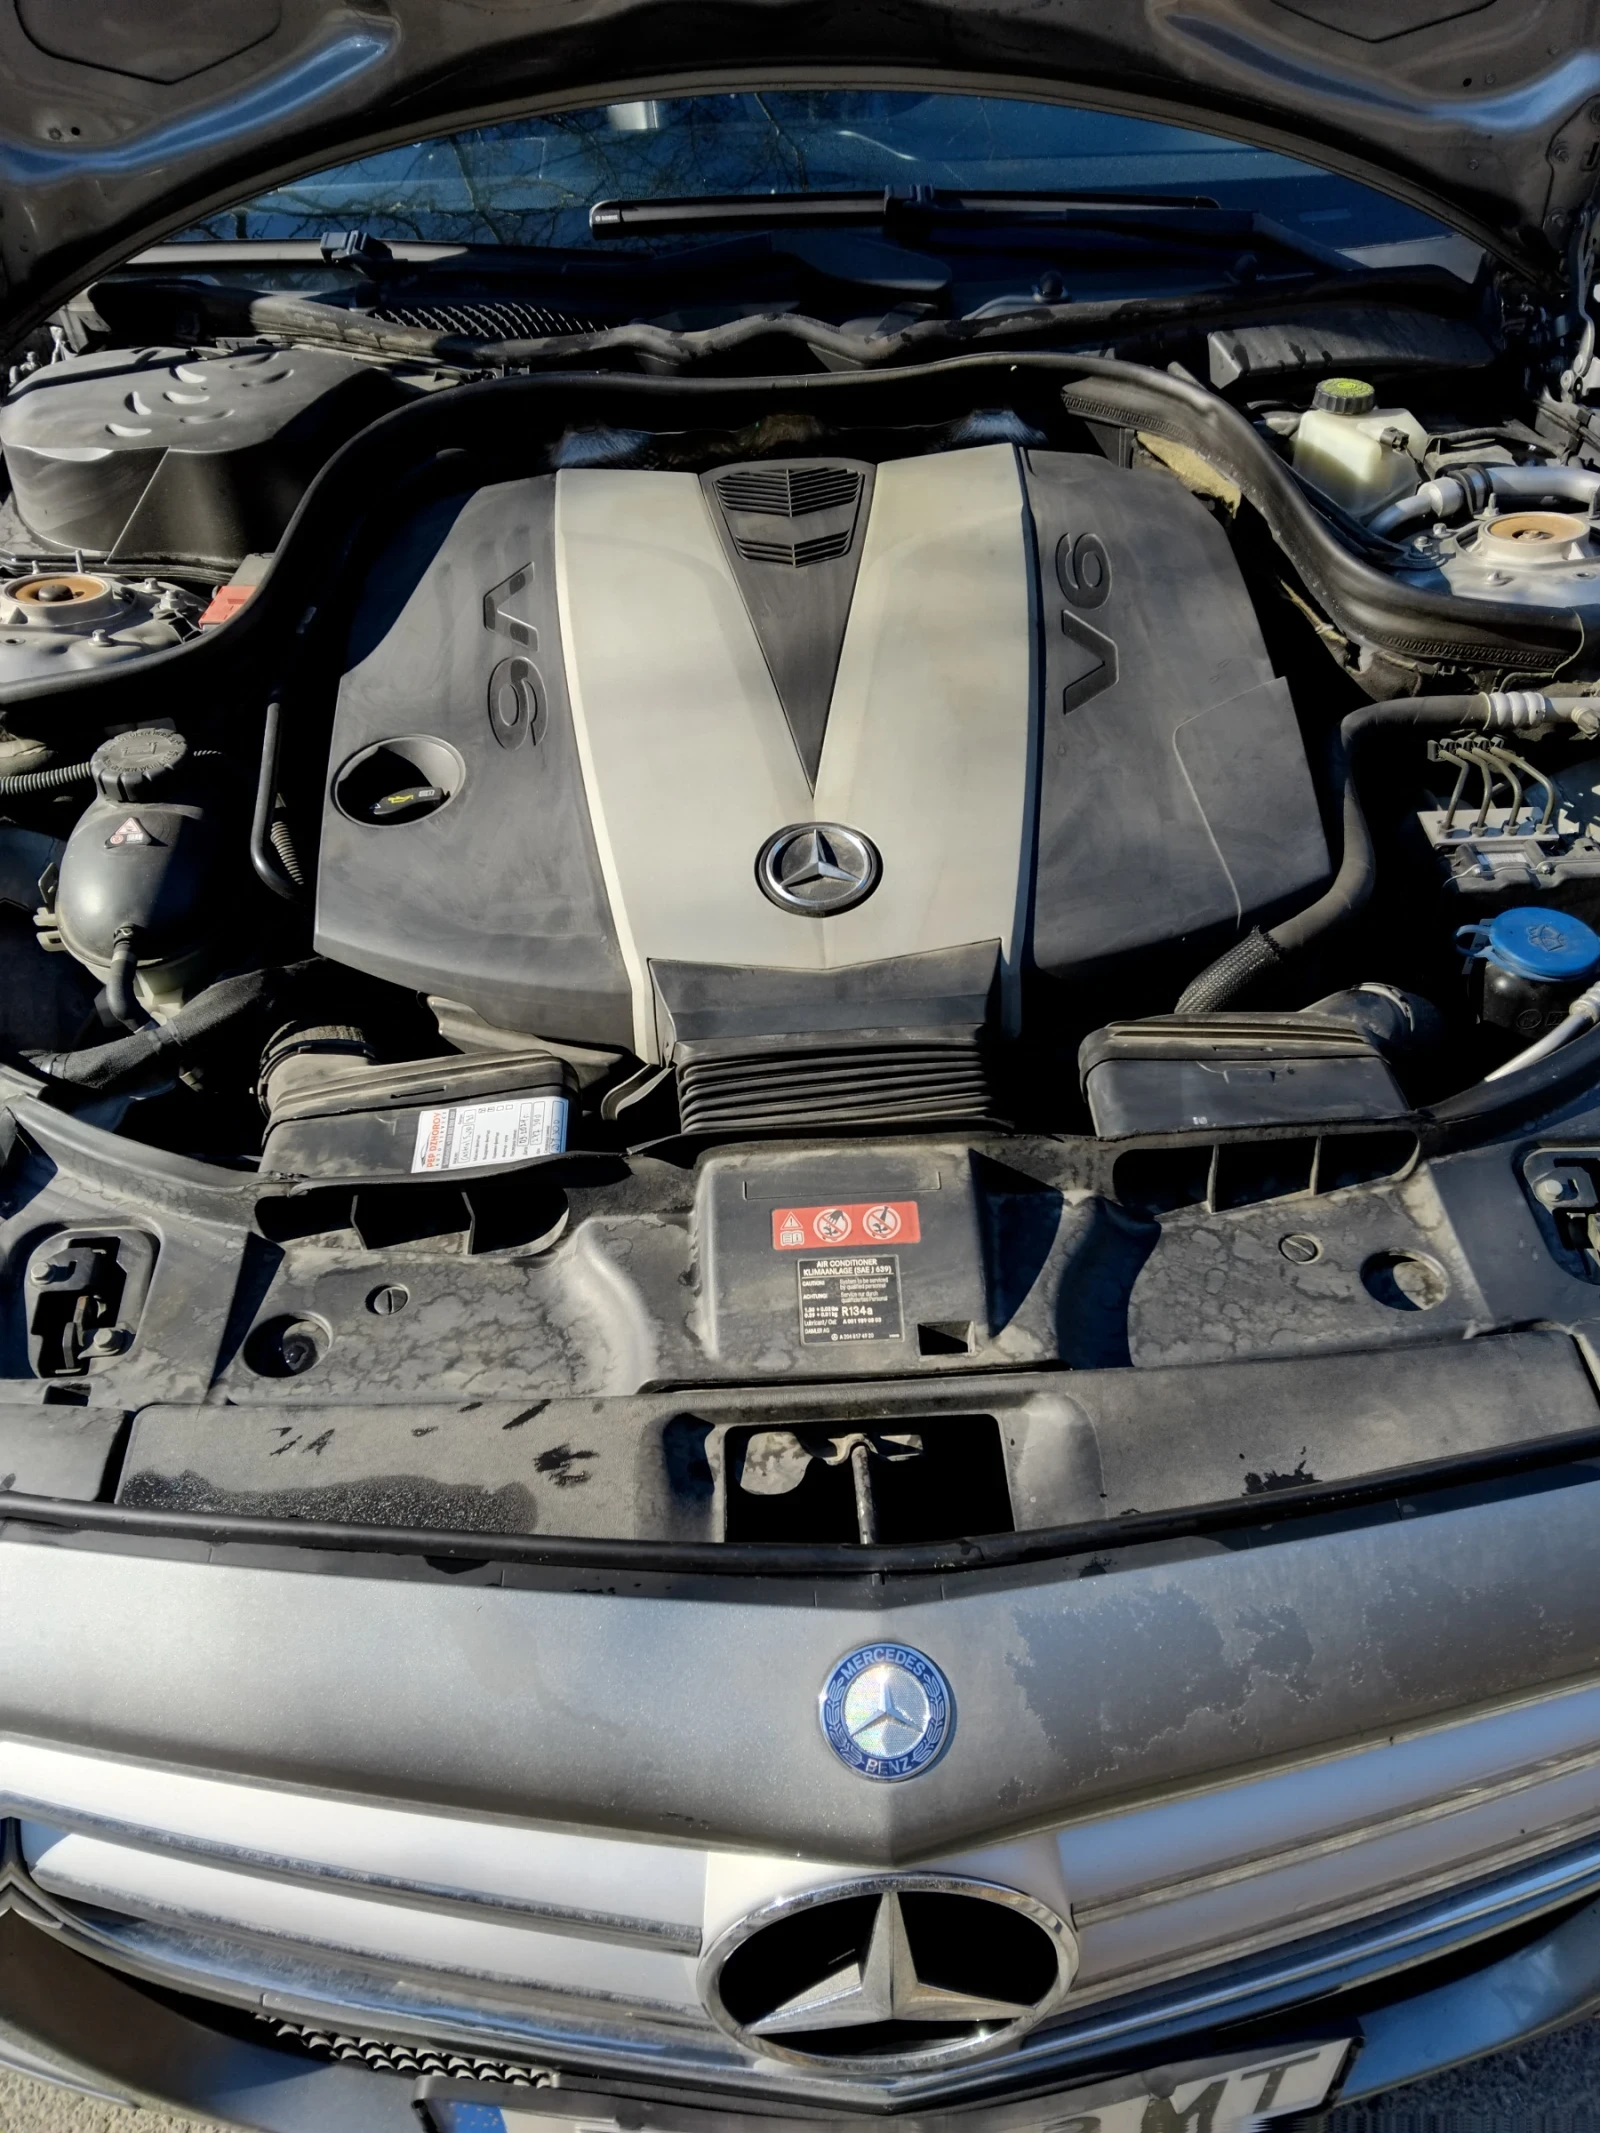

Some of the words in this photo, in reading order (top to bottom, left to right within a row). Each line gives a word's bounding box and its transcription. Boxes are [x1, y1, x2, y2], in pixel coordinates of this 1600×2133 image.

[1055, 532, 1119, 716] V6
[483, 562, 548, 750] V6
[426, 1151, 436, 1167] PEP
[803, 1267, 853, 1276] KLIMAANLAGE
[854, 1267, 870, 1275] (SAE
[876, 1266, 892, 1274] 639)
[816, 1260, 828, 1268] AIR
[830, 1258, 878, 1267] CONDITIONER
[841, 1306, 874, 1316] R134a
[841, 1648, 926, 1680] MERCEDES
[865, 1756, 912, 1775] BENZ
